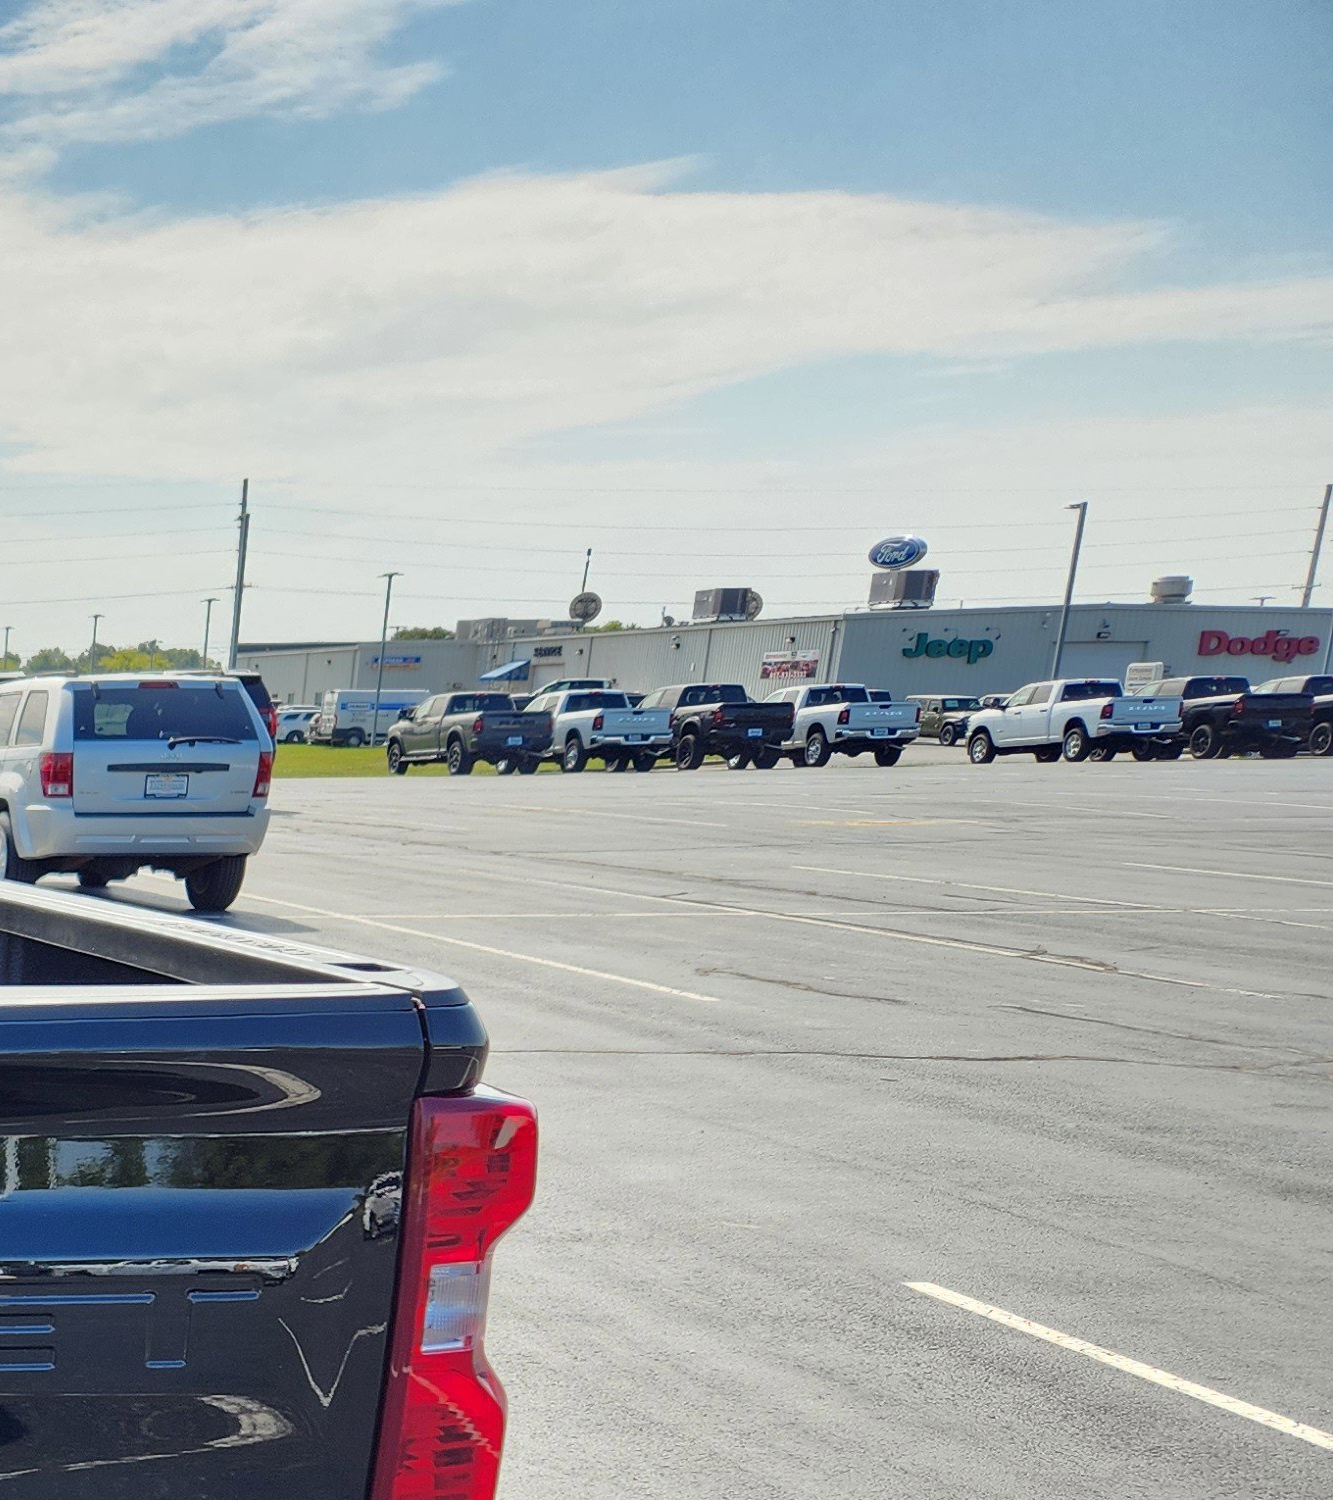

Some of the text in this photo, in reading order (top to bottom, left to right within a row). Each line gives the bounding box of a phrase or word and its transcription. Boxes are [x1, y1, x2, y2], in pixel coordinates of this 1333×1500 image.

[876, 542, 910, 563] Ford
[901, 632, 994, 664] Jeep
[1197, 629, 1320, 663] Dodge
